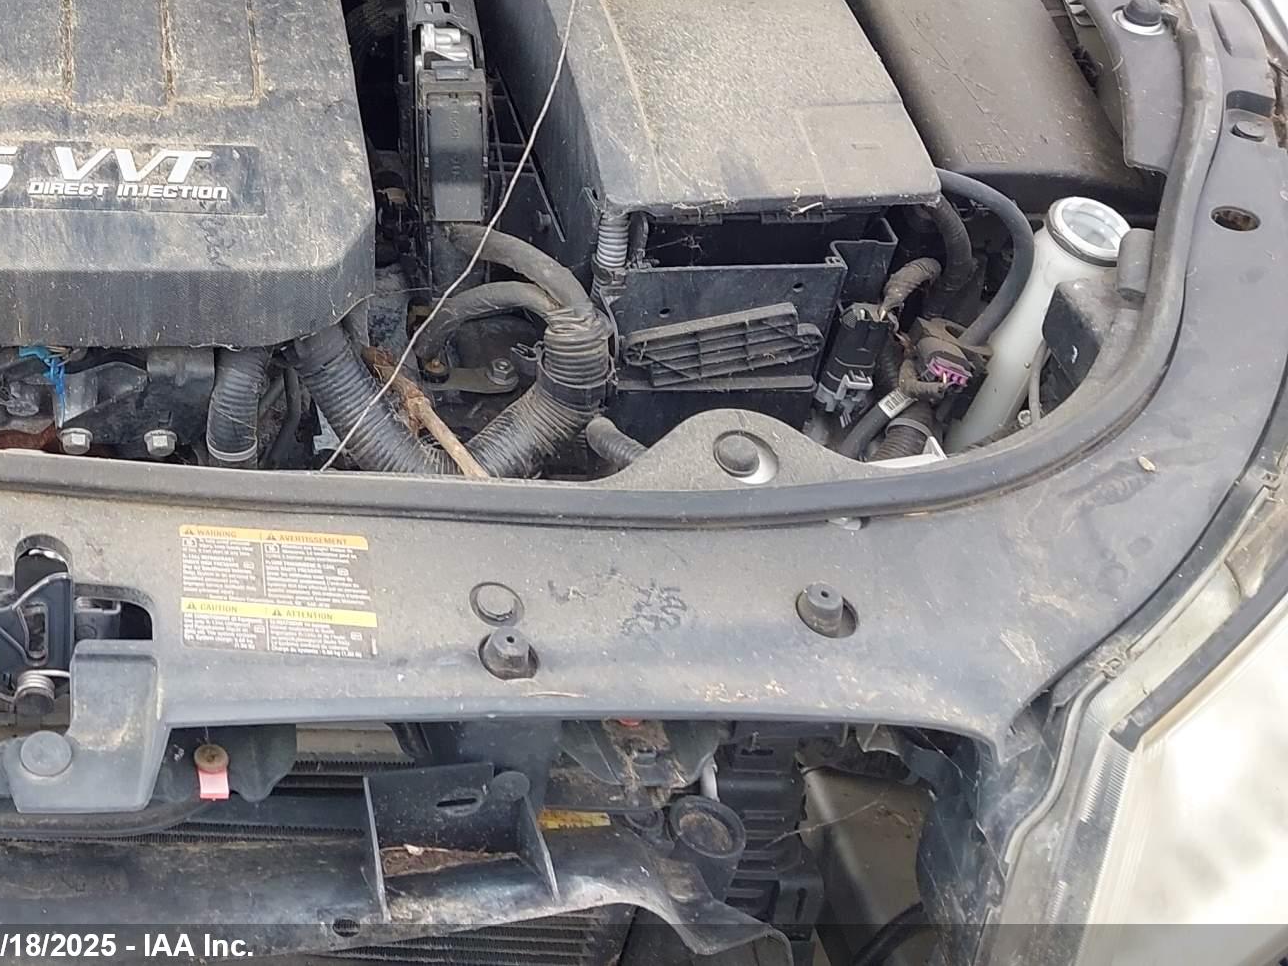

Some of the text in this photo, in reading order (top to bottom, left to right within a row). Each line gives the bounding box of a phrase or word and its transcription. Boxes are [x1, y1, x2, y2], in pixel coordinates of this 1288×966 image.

[54, 146, 212, 184] VVT
[28, 181, 228, 200] DIRECT INJECTION
[197, 529, 237, 539] WARNING
[279, 534, 348, 545] AVERTISSEMENT
[200, 603, 238, 613] CAUTION
[286, 609, 333, 621] ATTENTION
